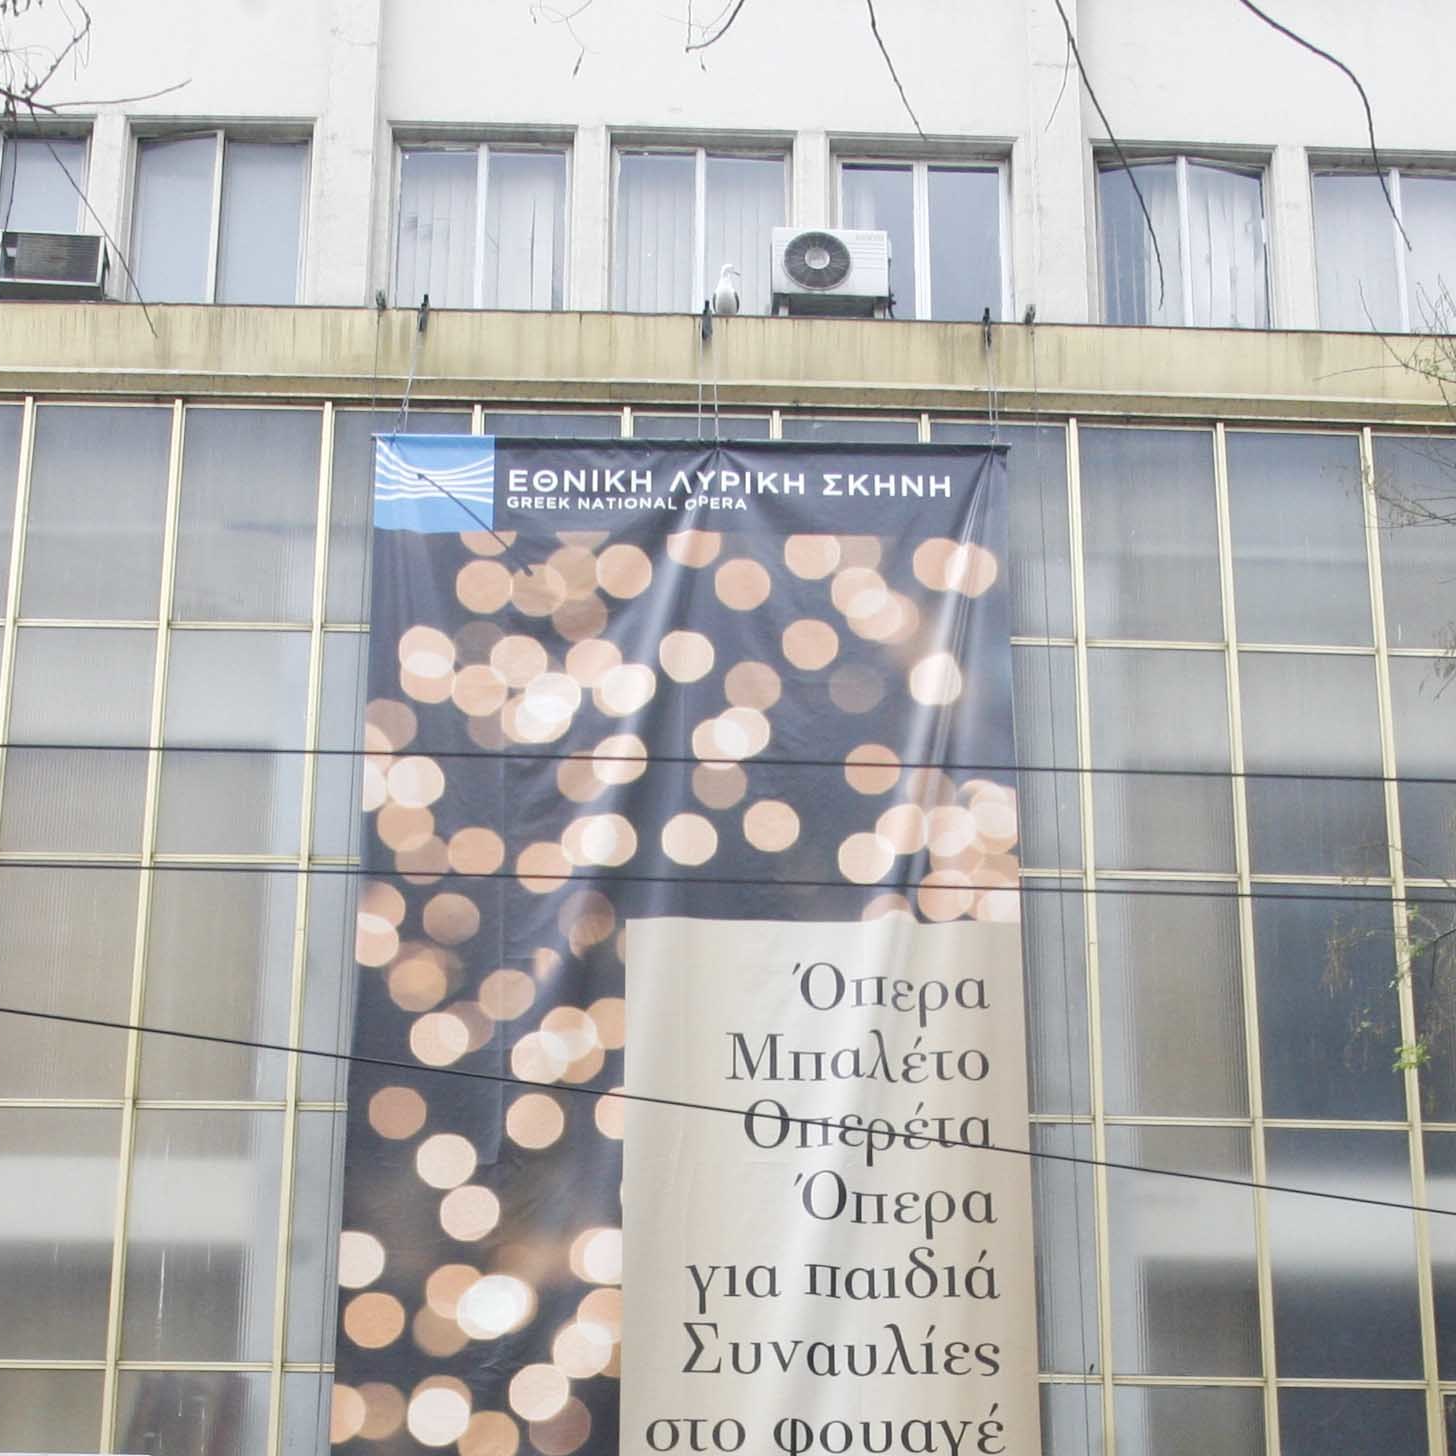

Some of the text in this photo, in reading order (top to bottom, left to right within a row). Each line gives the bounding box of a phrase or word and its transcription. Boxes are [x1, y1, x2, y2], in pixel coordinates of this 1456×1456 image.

[507, 496, 748, 512] GREEK NATIONAL OPERA
[508, 469, 952, 498] ΕΘΝΙΚΗ ΛΥΡΙΚΗ ΣΚΗΝΗ
[792, 962, 991, 1028] Όπερα
[725, 1029, 990, 1084] Μπαλέτο
[744, 1099, 996, 1167] Οπερέτα
[794, 1170, 998, 1240] Όπερα
[685, 1247, 1001, 1315] για παιδιά
[681, 1322, 1001, 1377] Συναυλίες
[645, 1418, 746, 1453] στο
